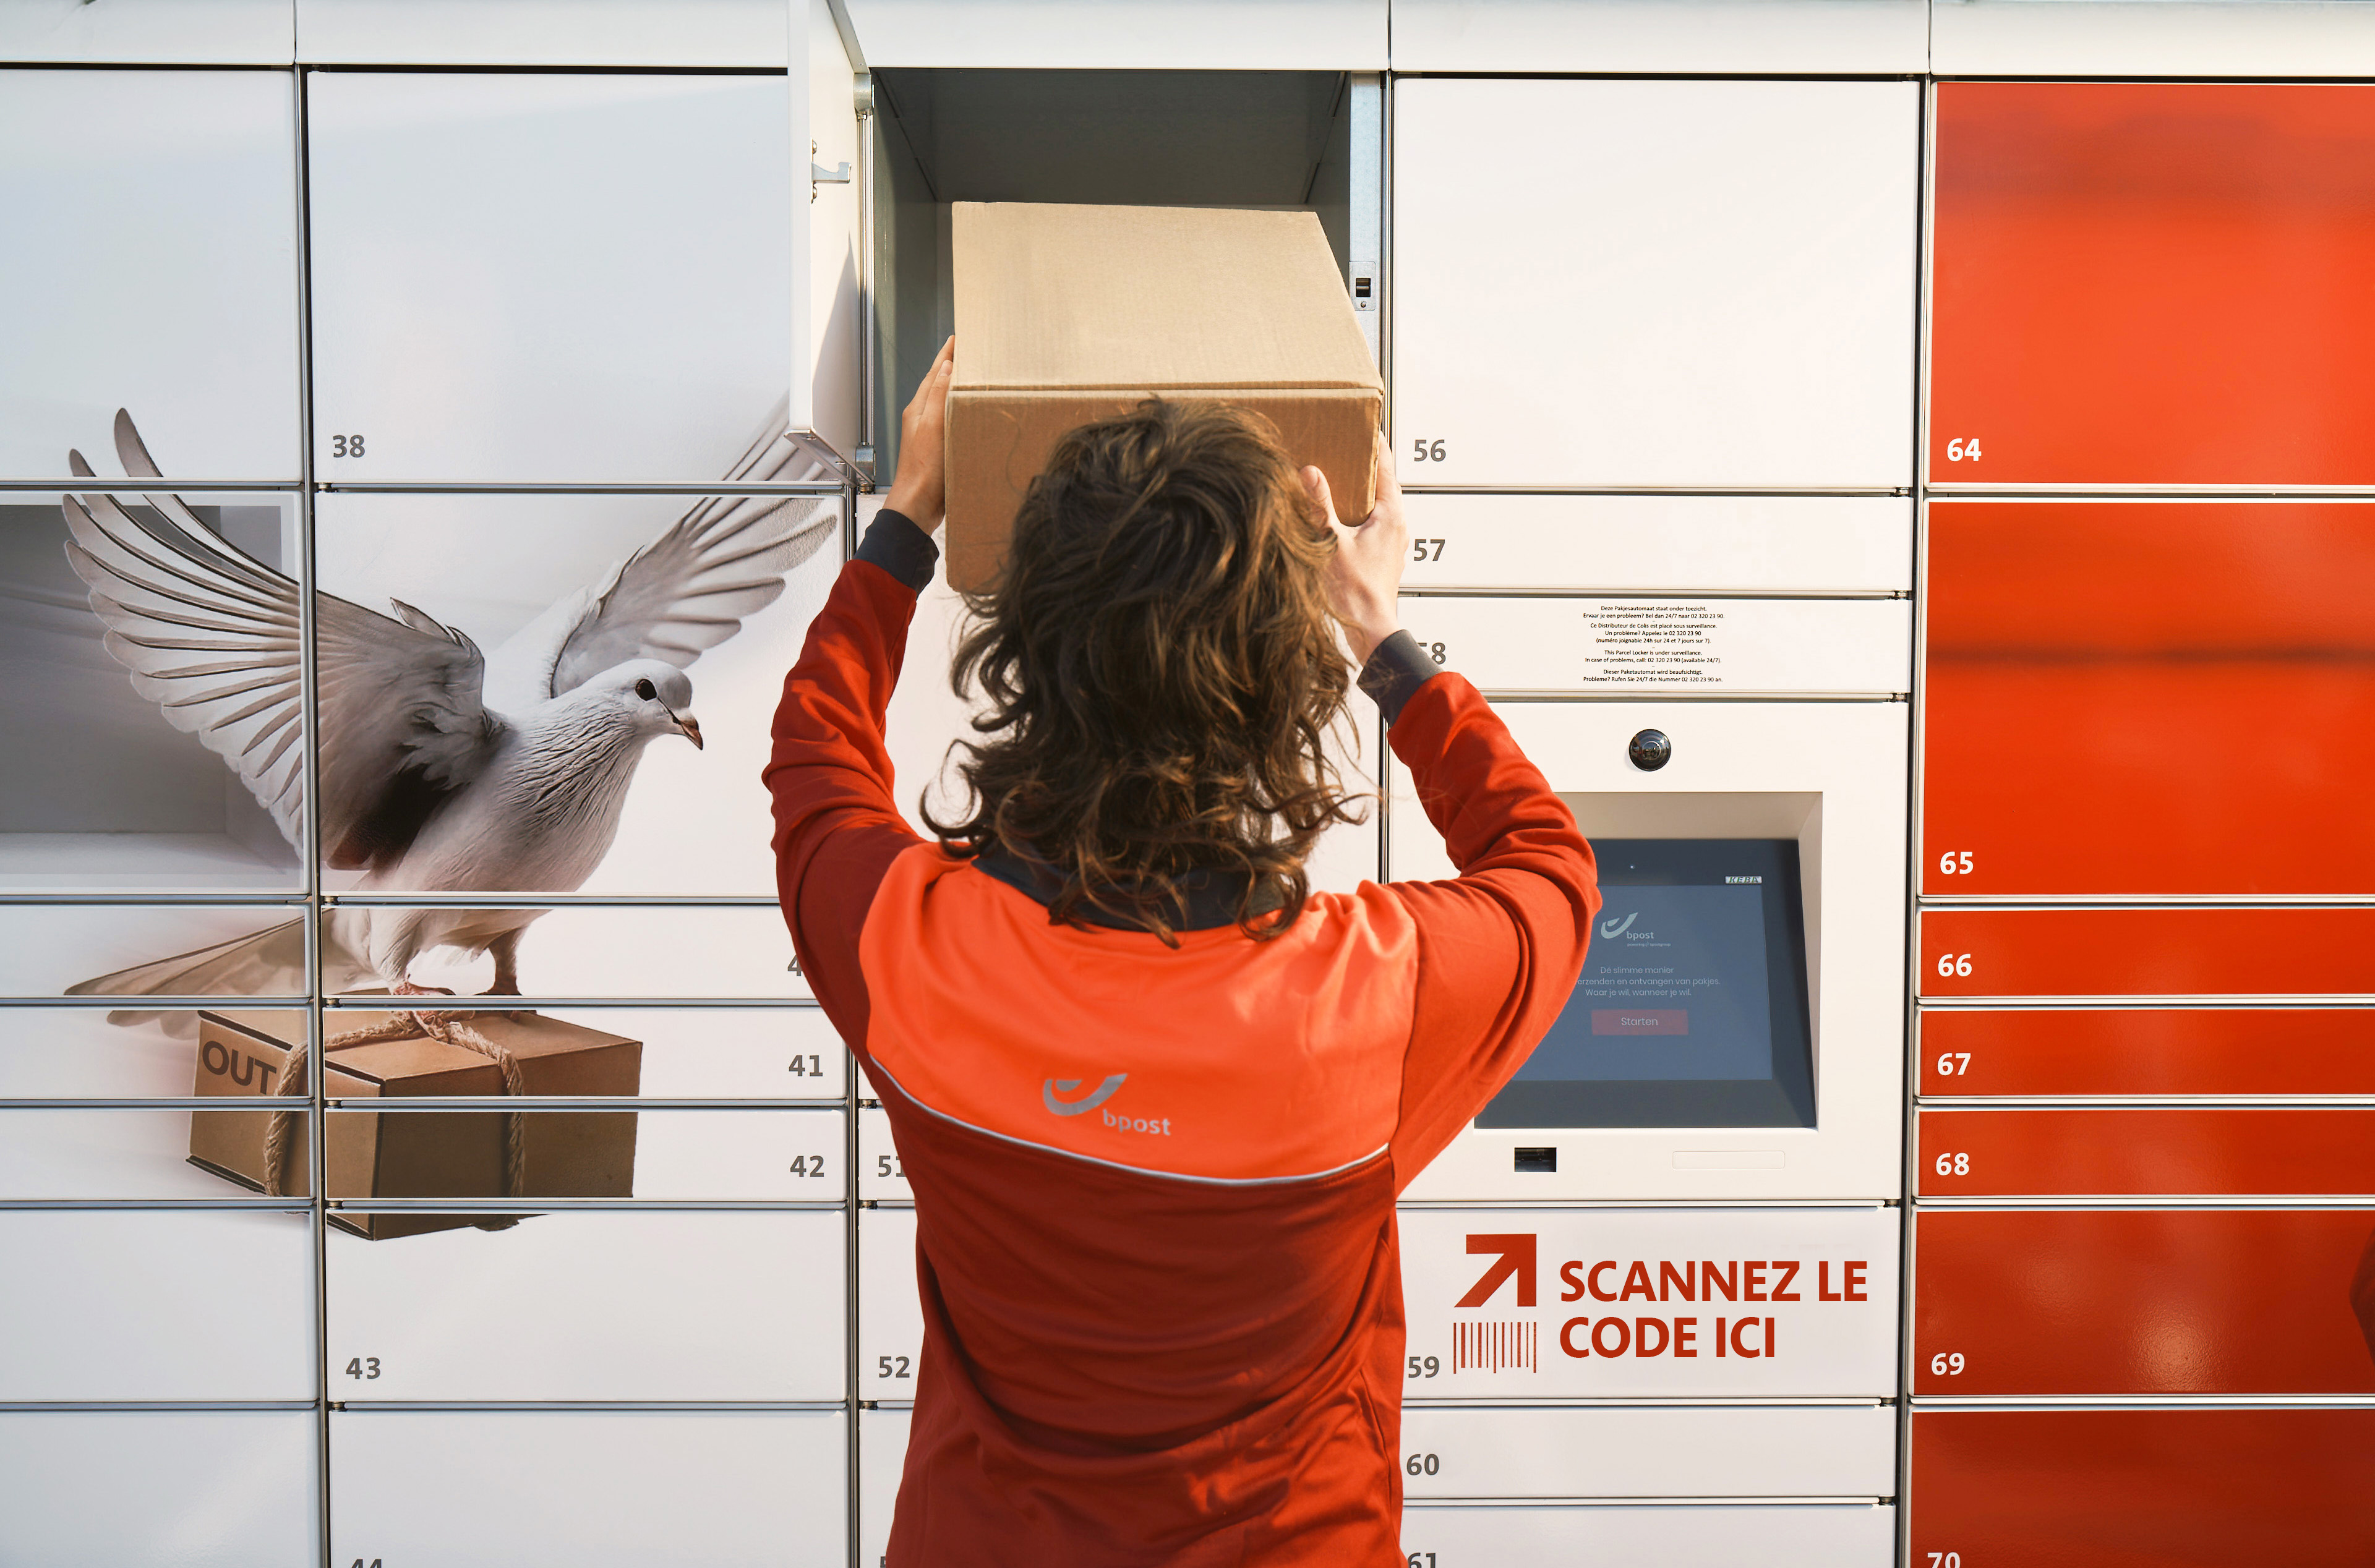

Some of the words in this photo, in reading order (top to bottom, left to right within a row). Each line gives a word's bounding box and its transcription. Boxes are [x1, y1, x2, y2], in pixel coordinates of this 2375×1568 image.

[333, 435, 366, 458] 38
[1414, 439, 1446, 462] 56
[1947, 438, 1982, 462] 64
[1414, 539, 1445, 561] 57
[1418, 642, 1446, 665] 8
[1940, 851, 1974, 875] 65
[1627, 931, 1654, 941] bpost
[787, 954, 803, 977] 4
[1938, 953, 1972, 977] 66
[1609, 988, 1617, 998] je
[1669, 988, 1677, 998] je
[1679, 988, 1692, 996] wil.
[1628, 978, 1674, 987] ontvangen
[1692, 977, 1721, 987] pakjes.
[1620, 1017, 1658, 1026] Starten
[202, 1040, 277, 1095] OUT
[789, 1055, 823, 1077] 41
[1937, 1052, 1971, 1076] 67
[1102, 1109, 1171, 1136] bpost
[790, 1155, 824, 1178] 42
[1936, 1153, 1969, 1176] 68
[1560, 1260, 1800, 1302] SCANNEZ
[1818, 1261, 1867, 1302] LE
[1560, 1316, 1697, 1358] CODE
[1716, 1316, 1775, 1358] ICI
[346, 1357, 380, 1379] 43
[879, 1356, 910, 1378] 52
[1408, 1356, 1440, 1378] 59
[1931, 1352, 1965, 1376] 69
[1406, 1454, 1440, 1476] 60
